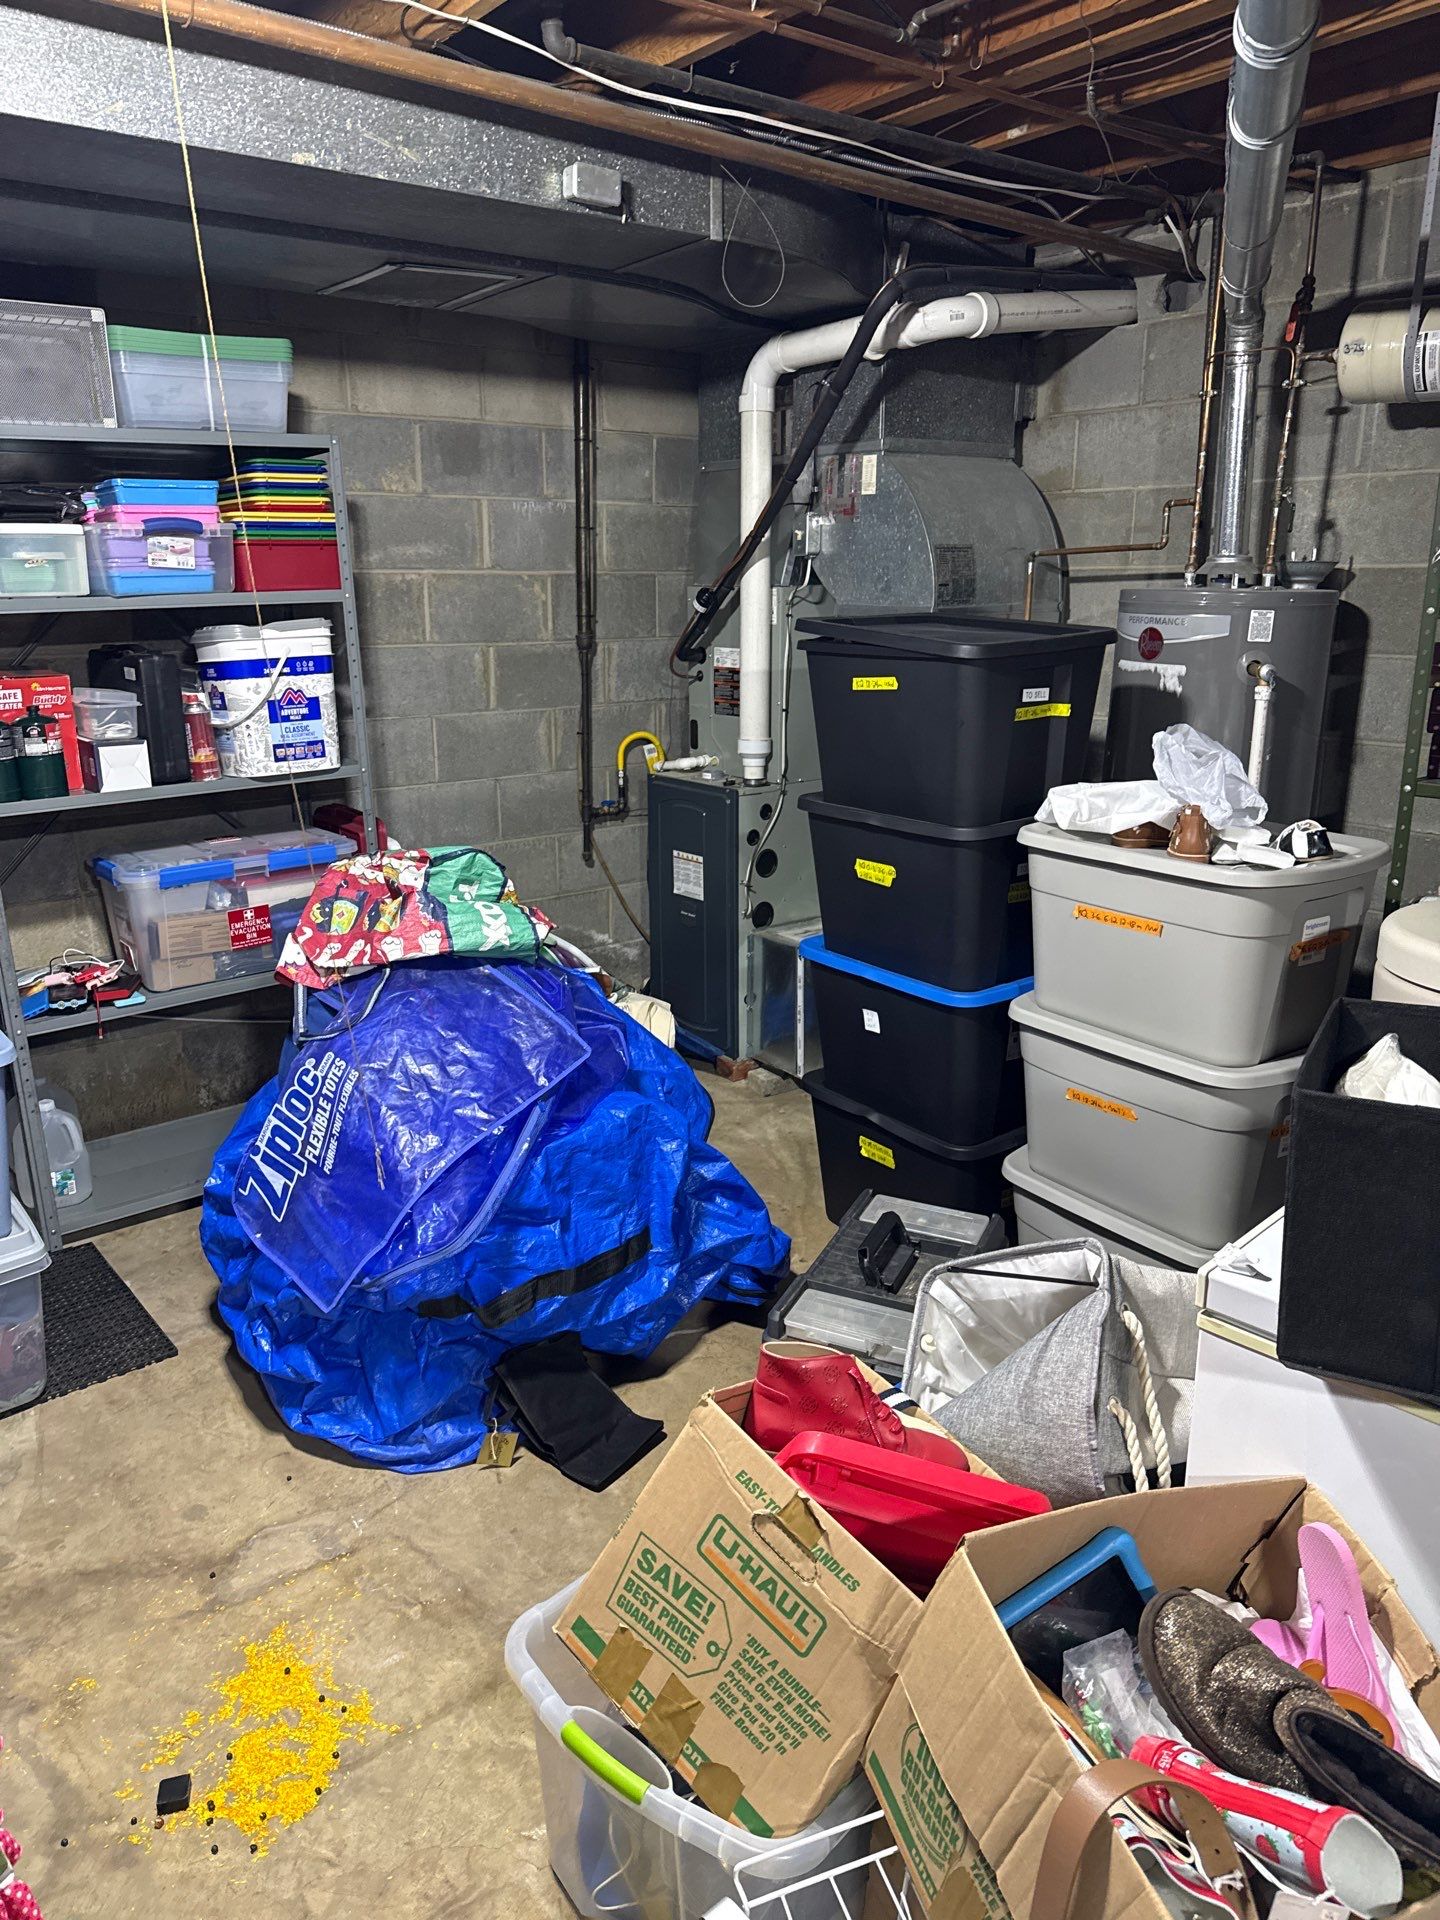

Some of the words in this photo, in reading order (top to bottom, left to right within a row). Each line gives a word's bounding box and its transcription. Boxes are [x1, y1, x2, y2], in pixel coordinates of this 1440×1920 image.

[1128, 615, 1187, 627] PERFORMANCE
[33, 694, 67, 705] Buddy
[281, 708, 309, 716] ADVENTURE
[284, 725, 310, 733] CLASSIC
[230, 923, 271, 937] EVACUATION
[231, 917, 269, 930] EMERGENCY
[246, 932, 257, 940] BIN
[320, 1053, 334, 1075] BRAND
[259, 1118, 273, 1144] MARQUE
[305, 1097, 332, 1165] FLEXIBLE
[322, 1057, 347, 1100] TOTES
[323, 1112, 344, 1175] FOURRE-TOUT
[338, 1069, 360, 1115] FLEXIBLES
[623, 1577, 659, 1612] BEST
[658, 1606, 700, 1649] PRICE
[637, 1548, 716, 1626] SAVE!
[766, 1658, 780, 1671] A
[709, 1691, 738, 1719] FREE
[734, 1719, 770, 1754] Boxes!
[717, 1682, 739, 1705] Give
[741, 1704, 760, 1725] You
[758, 1722, 776, 1742] $20
[774, 1741, 788, 1755] in
[724, 1670, 754, 1702] Prices
[754, 1702, 776, 1723] and
[774, 1721, 802, 1750] We'll
[731, 1659, 757, 1685] Beat
[754, 1683, 774, 1703] Our
[772, 1702, 809, 1740] Bundle
[739, 1648, 768, 1677] SAVE
[765, 1674, 796, 1705] EVEN
[792, 1702, 832, 1743] MORE!
[901, 1766, 951, 1859] GUARANTE
[970, 1859, 999, 1913] TAKE
